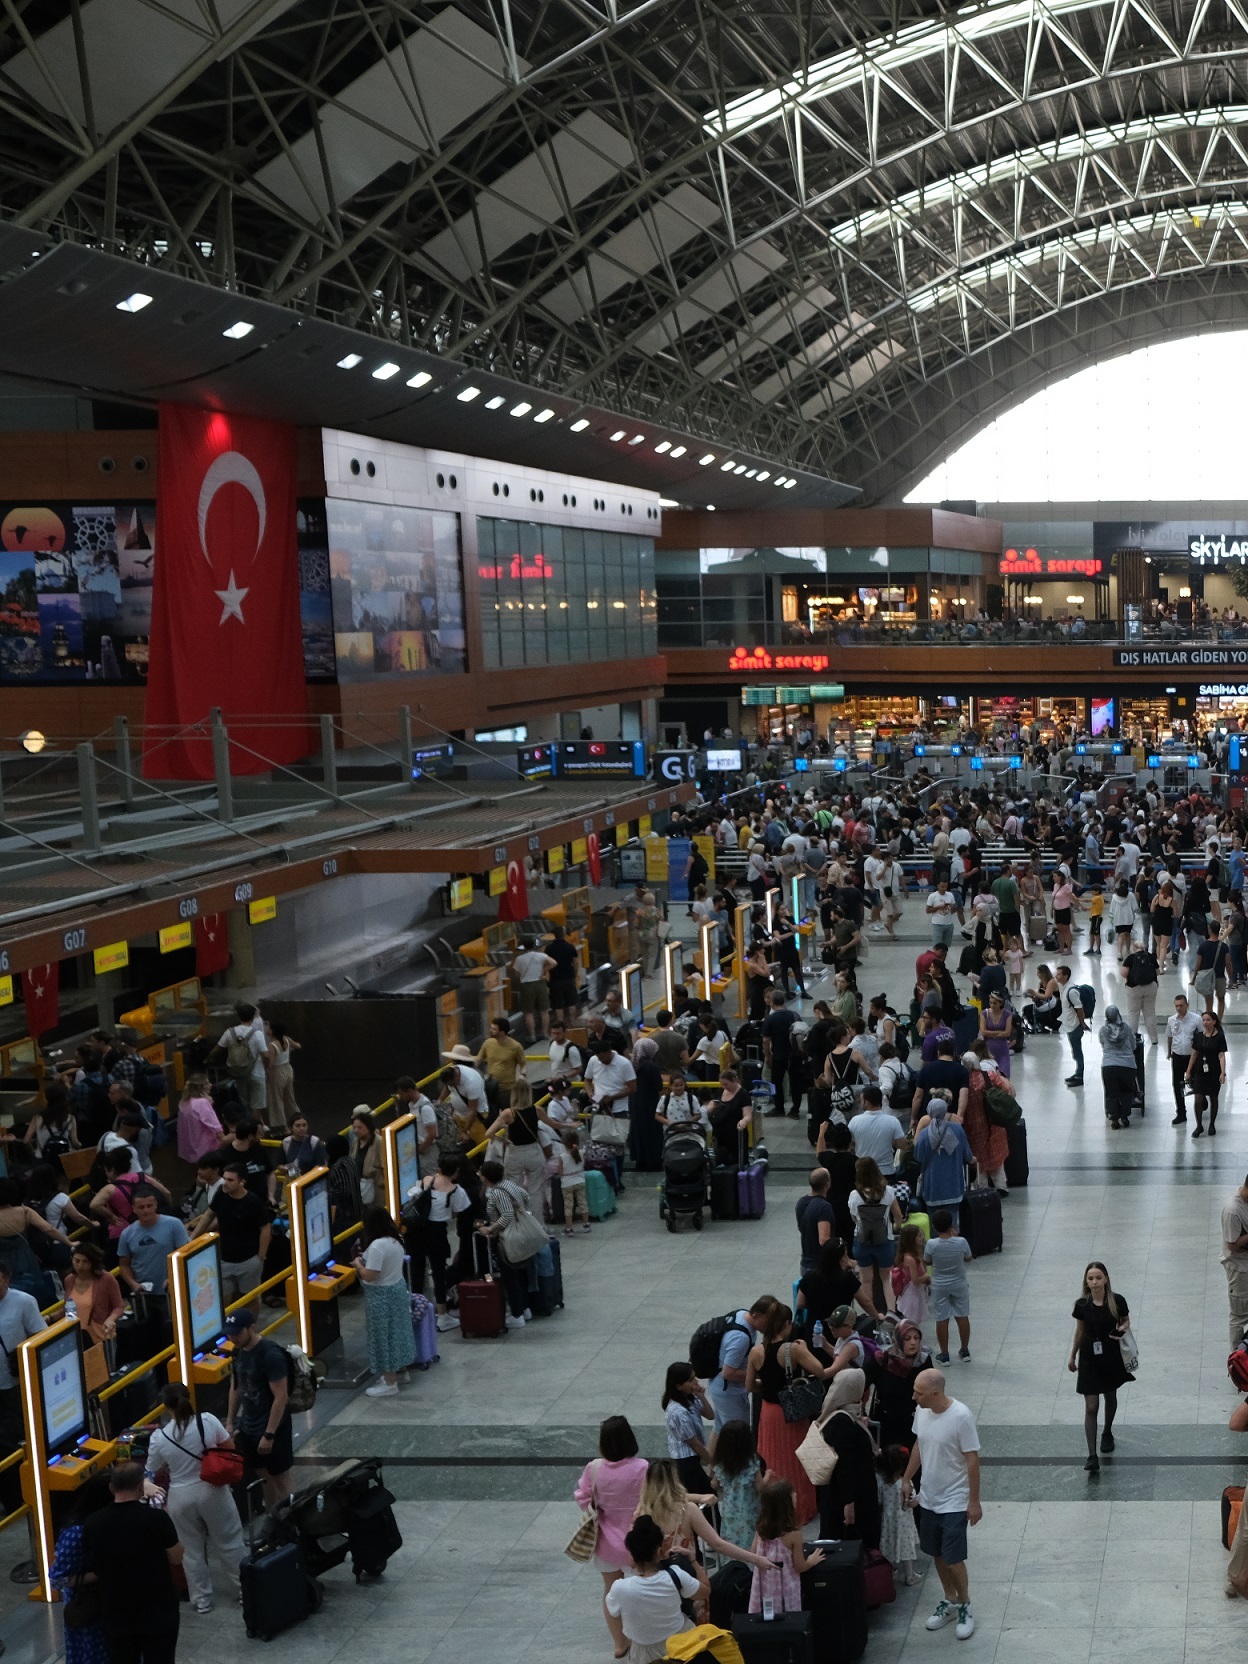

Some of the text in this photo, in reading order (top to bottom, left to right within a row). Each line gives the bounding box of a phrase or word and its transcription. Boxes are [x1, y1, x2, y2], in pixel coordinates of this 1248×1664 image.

[1000, 549, 1102, 577] simit sarayı
[729, 647, 829, 672] simit sarayı
[1120, 651, 1140, 666] DIŞ
[1143, 651, 1187, 664] HATLAR
[1190, 649, 1228, 663] GİDEN
[1199, 684, 1237, 695] SABİHA
[323, 859, 337, 875] G10
[179, 898, 198, 918] G08
[64, 929, 86, 951] G07
